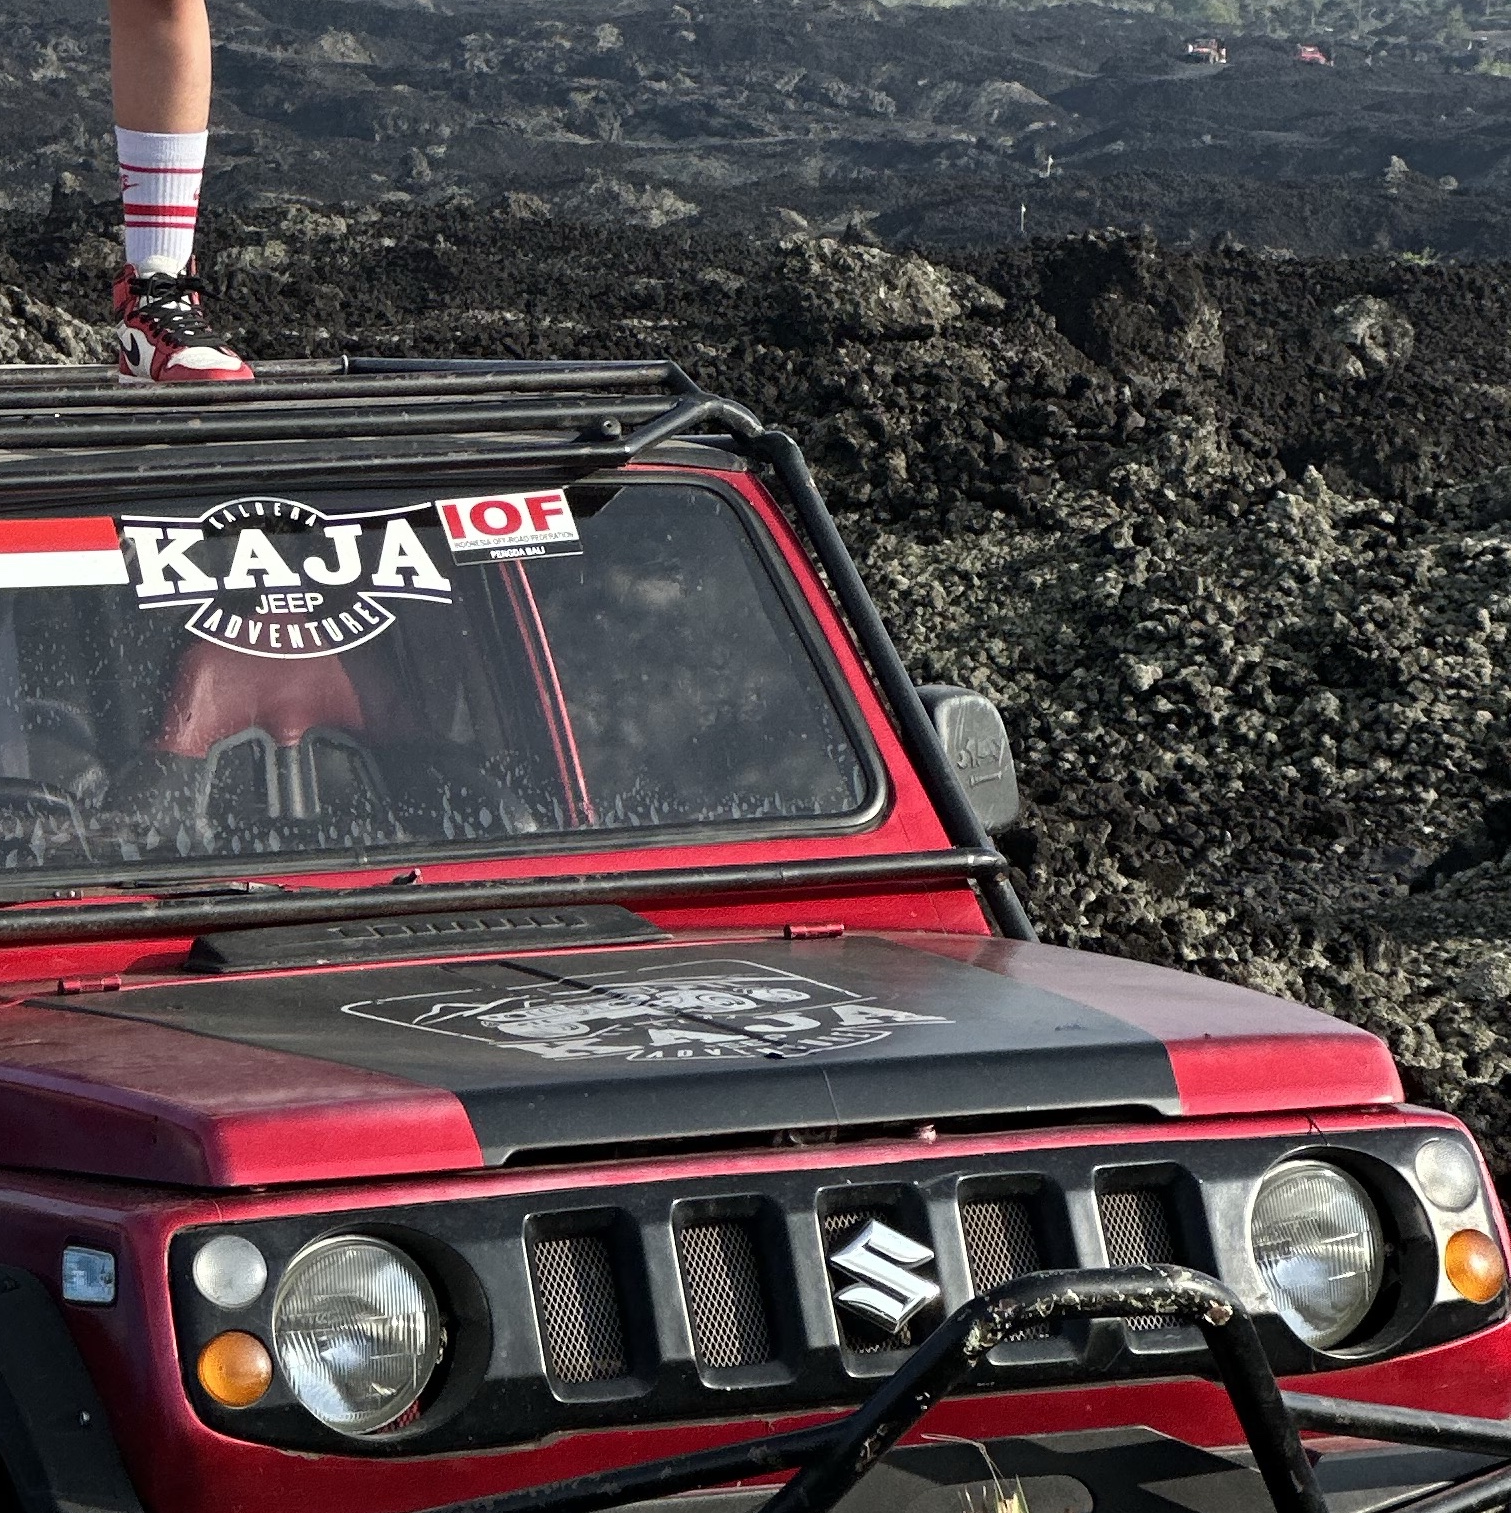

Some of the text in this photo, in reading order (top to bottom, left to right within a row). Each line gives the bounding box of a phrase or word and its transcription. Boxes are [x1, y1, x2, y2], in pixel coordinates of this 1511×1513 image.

[442, 495, 564, 540] IOF
[123, 518, 453, 598] KAJA
[202, 601, 381, 649] ADVENTURE
[255, 592, 325, 615] JEEP
